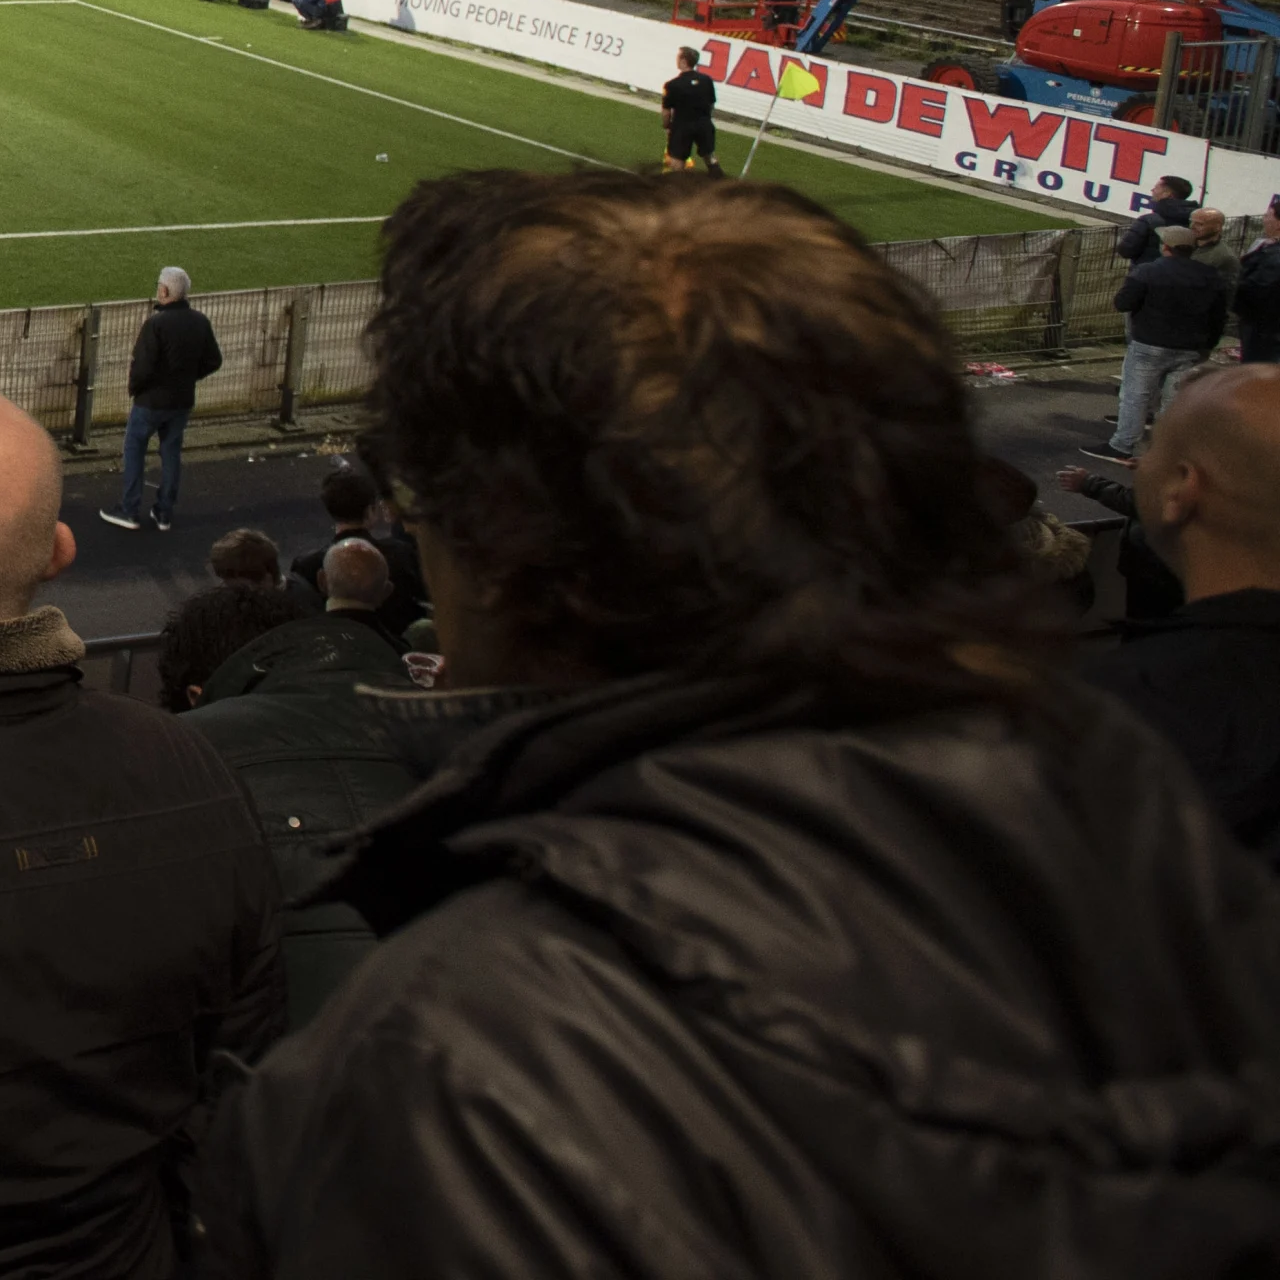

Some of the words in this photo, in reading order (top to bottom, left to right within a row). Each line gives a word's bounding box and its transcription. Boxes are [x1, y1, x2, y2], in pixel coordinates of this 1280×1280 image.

[465, 3, 526, 33] PEOPLE
[529, 18, 579, 46] SINCE
[584, 31, 624, 57] 1923
[696, 38, 828, 109] JAN
[843, 71, 948, 138] DE
[962, 95, 1168, 185] WIT
[954, 151, 1153, 213] GROUP
